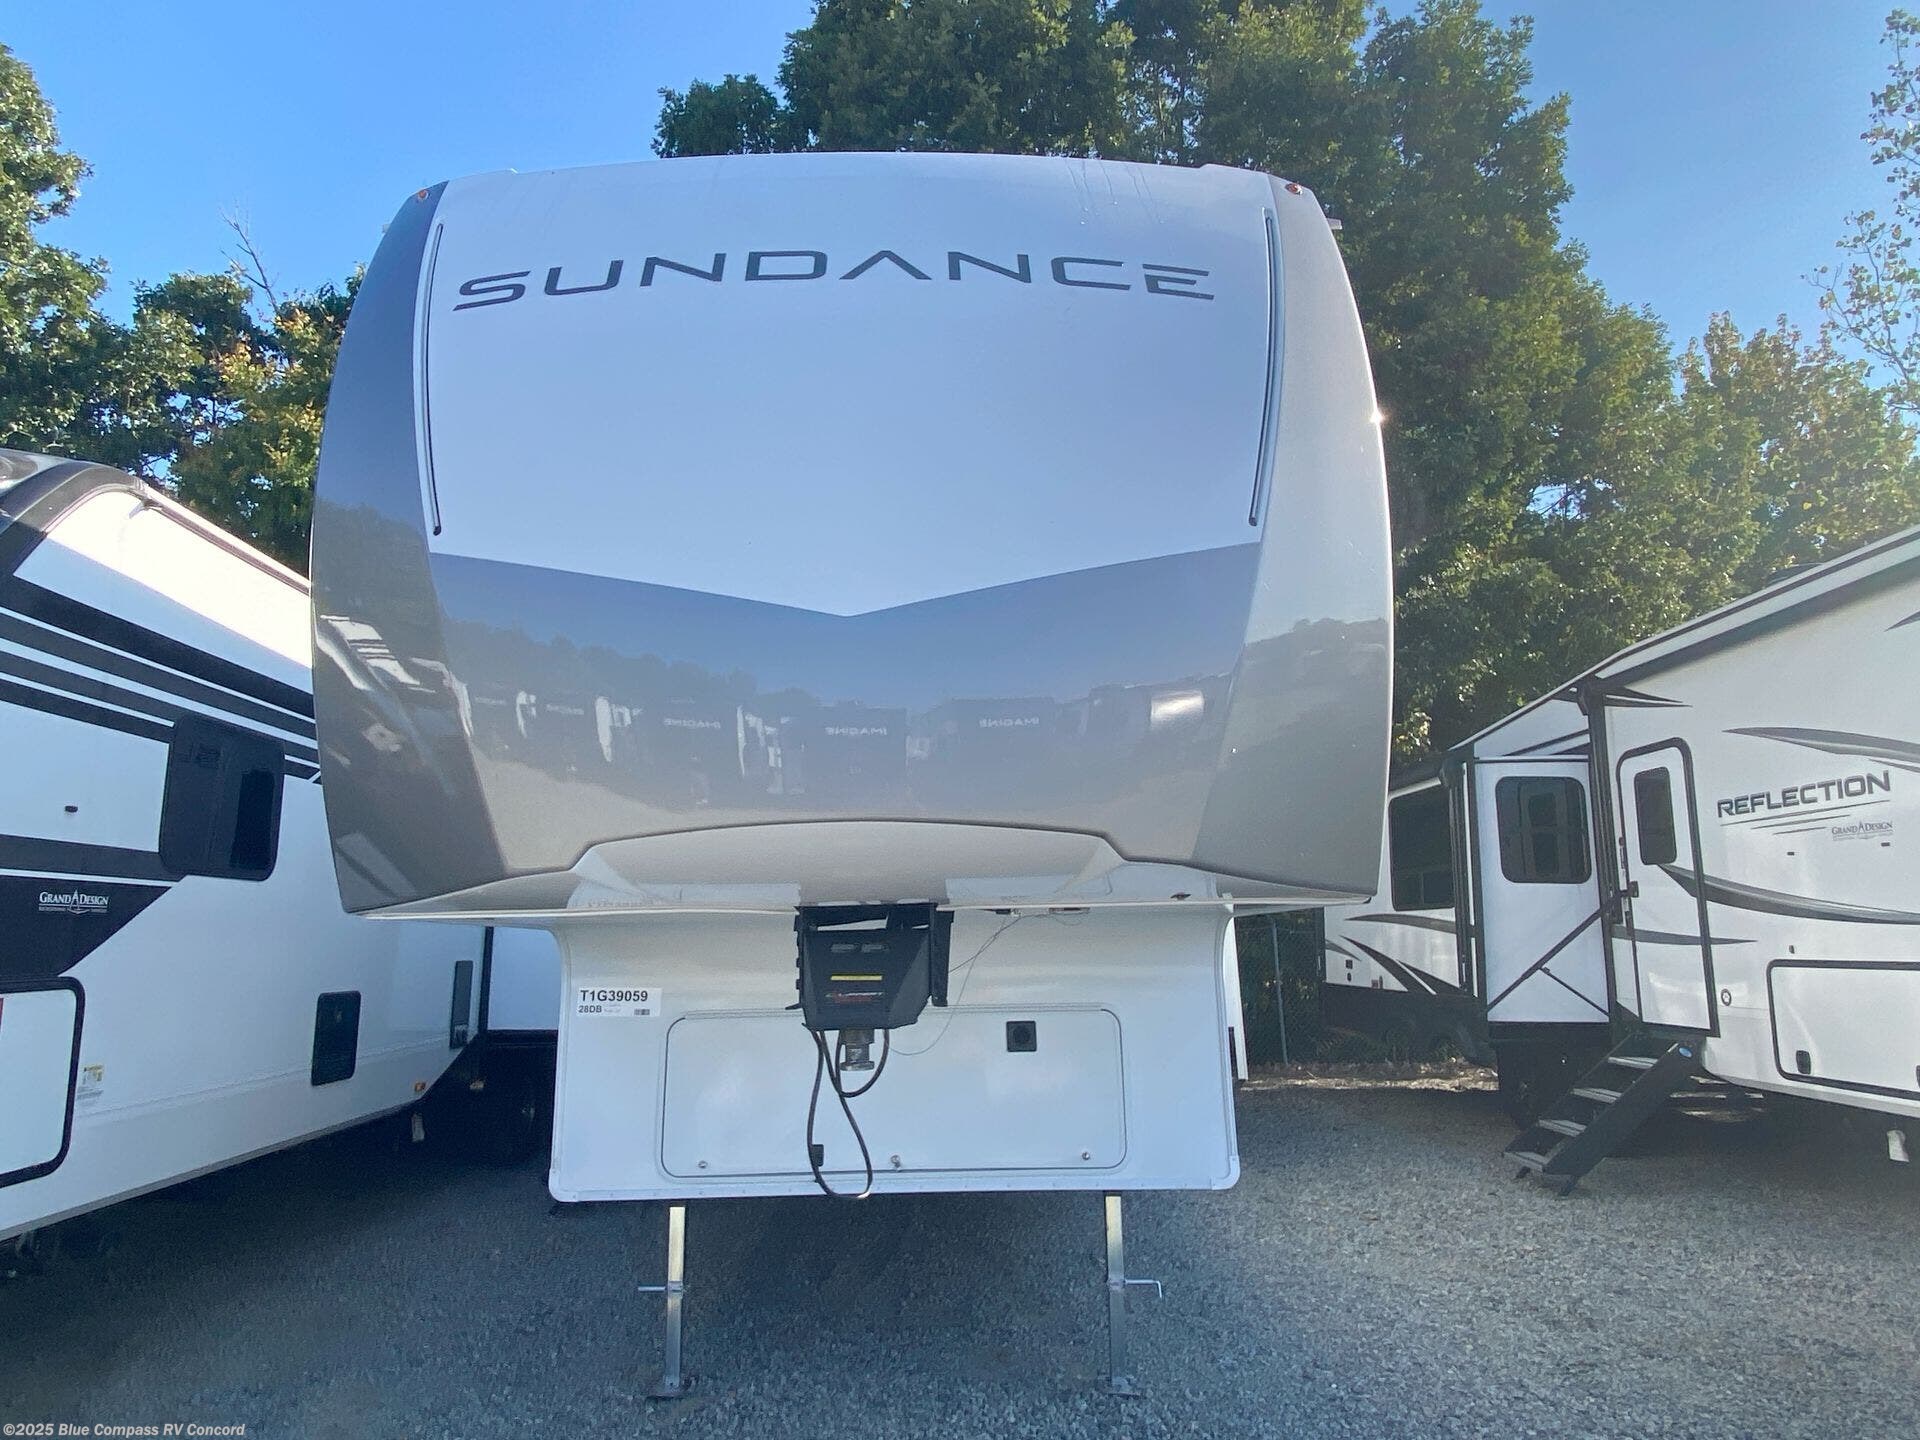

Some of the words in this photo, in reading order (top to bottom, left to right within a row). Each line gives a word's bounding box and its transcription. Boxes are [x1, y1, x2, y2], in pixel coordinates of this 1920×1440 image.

[452, 249, 1215, 311] SUNDANCE
[1717, 770, 1891, 818] REFLECTION
[1832, 826, 1858, 835] GRAND
[1864, 820, 1893, 832] DESIGN
[39, 891, 71, 904] GRAND
[79, 893, 110, 905] DESIGN
[580, 989, 649, 1002] T1G39059
[578, 1004, 603, 1014] 28DB
